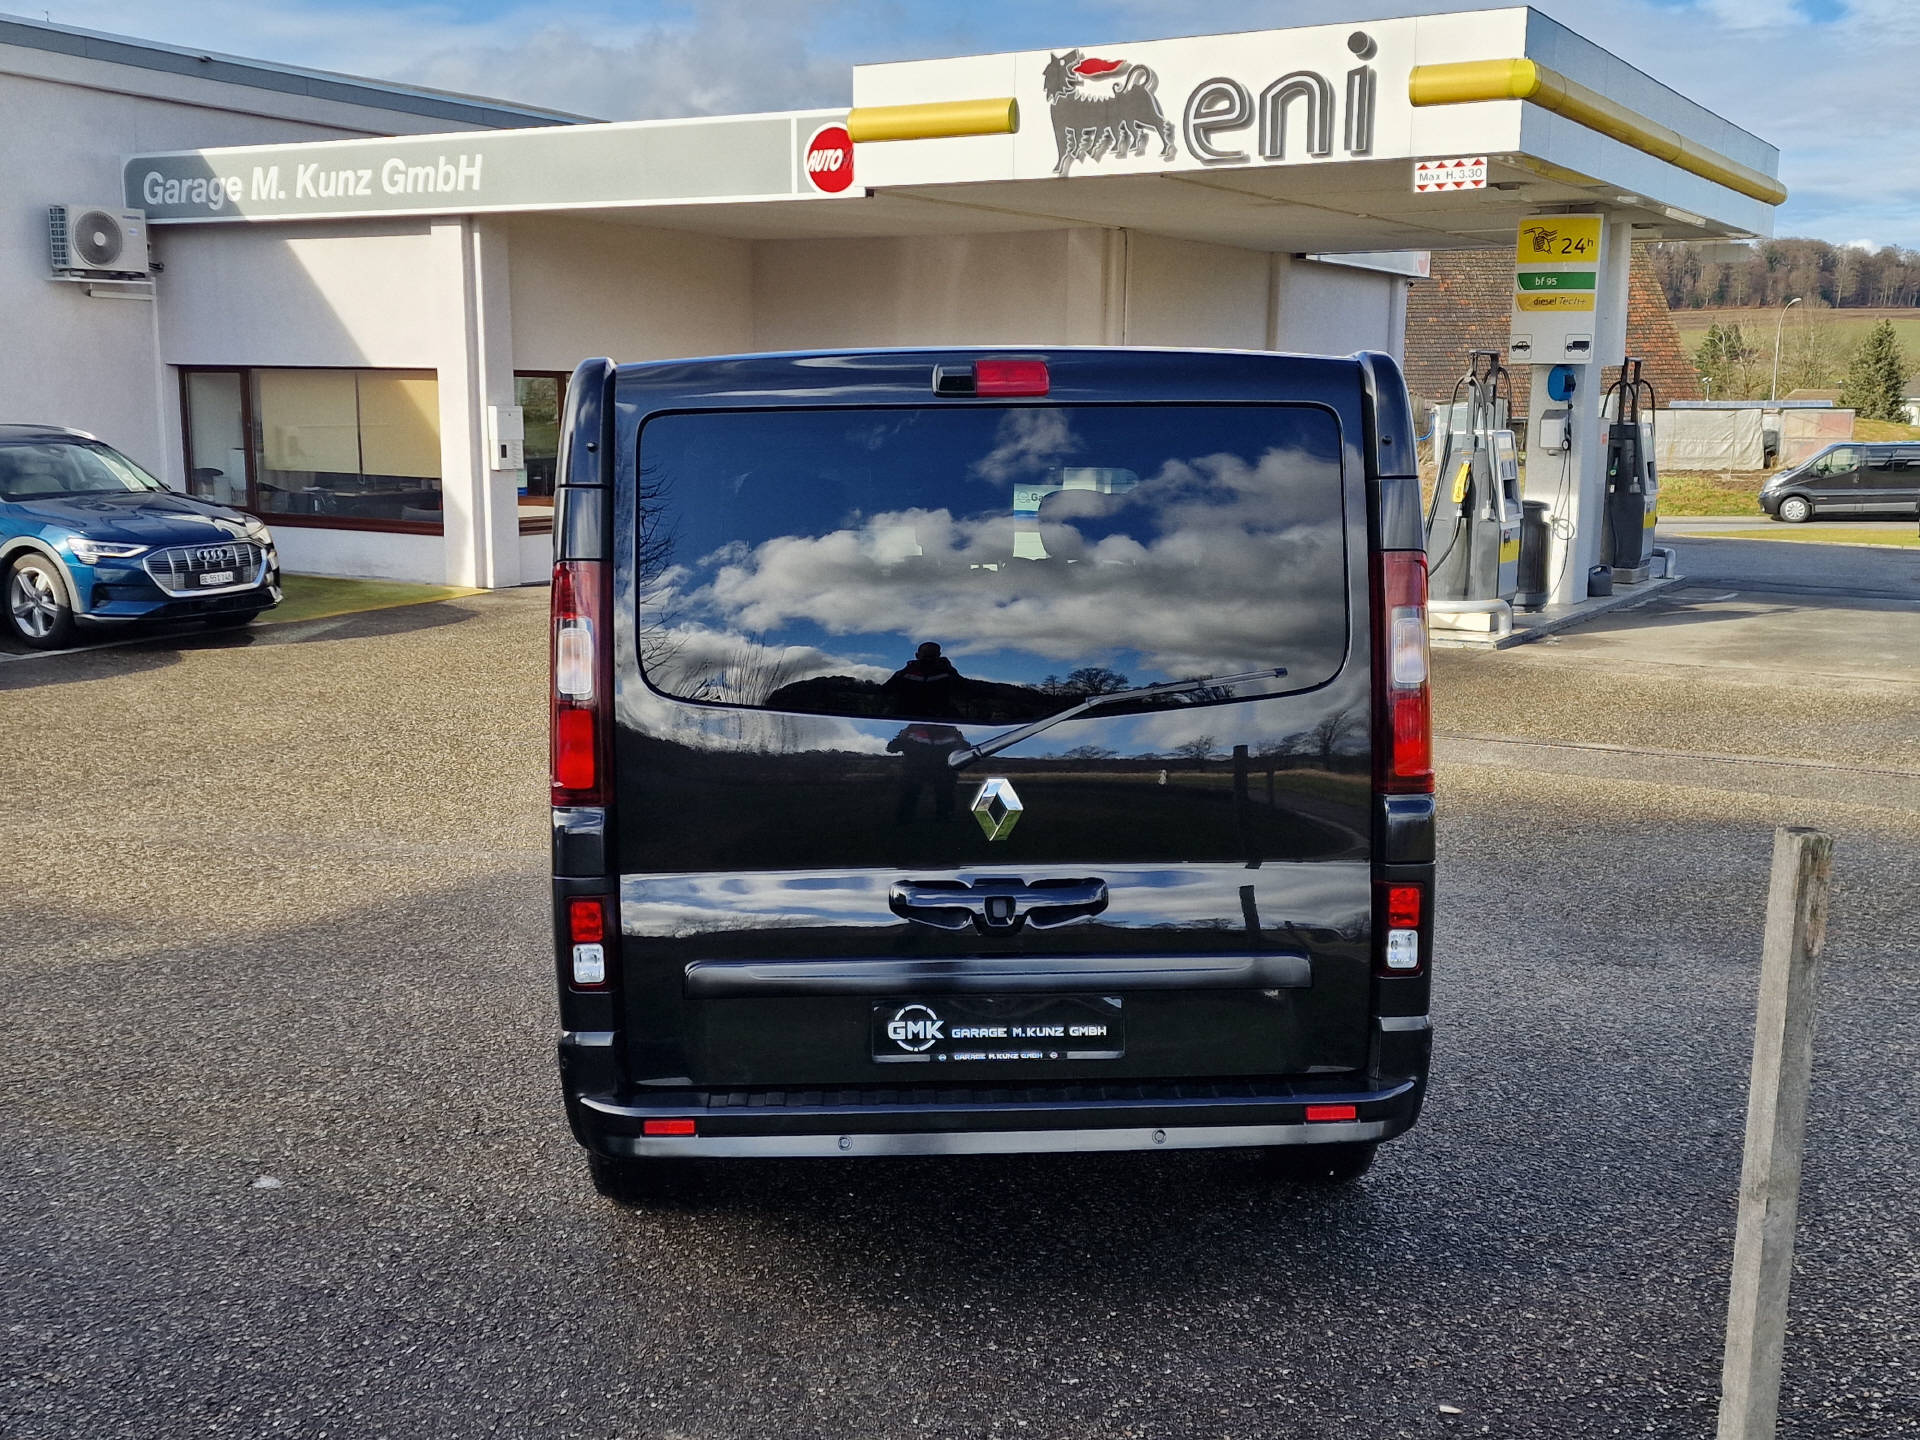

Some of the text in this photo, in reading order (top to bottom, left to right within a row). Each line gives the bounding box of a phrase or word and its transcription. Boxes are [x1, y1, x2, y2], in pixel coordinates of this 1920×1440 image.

[1183, 31, 1375, 164] eni
[807, 148, 844, 172] AUTO
[1419, 173, 1441, 182] Max
[1459, 168, 1483, 179] 3.30
[143, 154, 483, 211] Garage M. Kunz GmbH
[1546, 277, 1558, 286] 95
[1533, 296, 1557, 306] diesel
[888, 1020, 944, 1040] GMK
[951, 1025, 1107, 1038] GARAGE M.KUNZ GMBH
[954, 1052, 986, 1060] GARAGE
